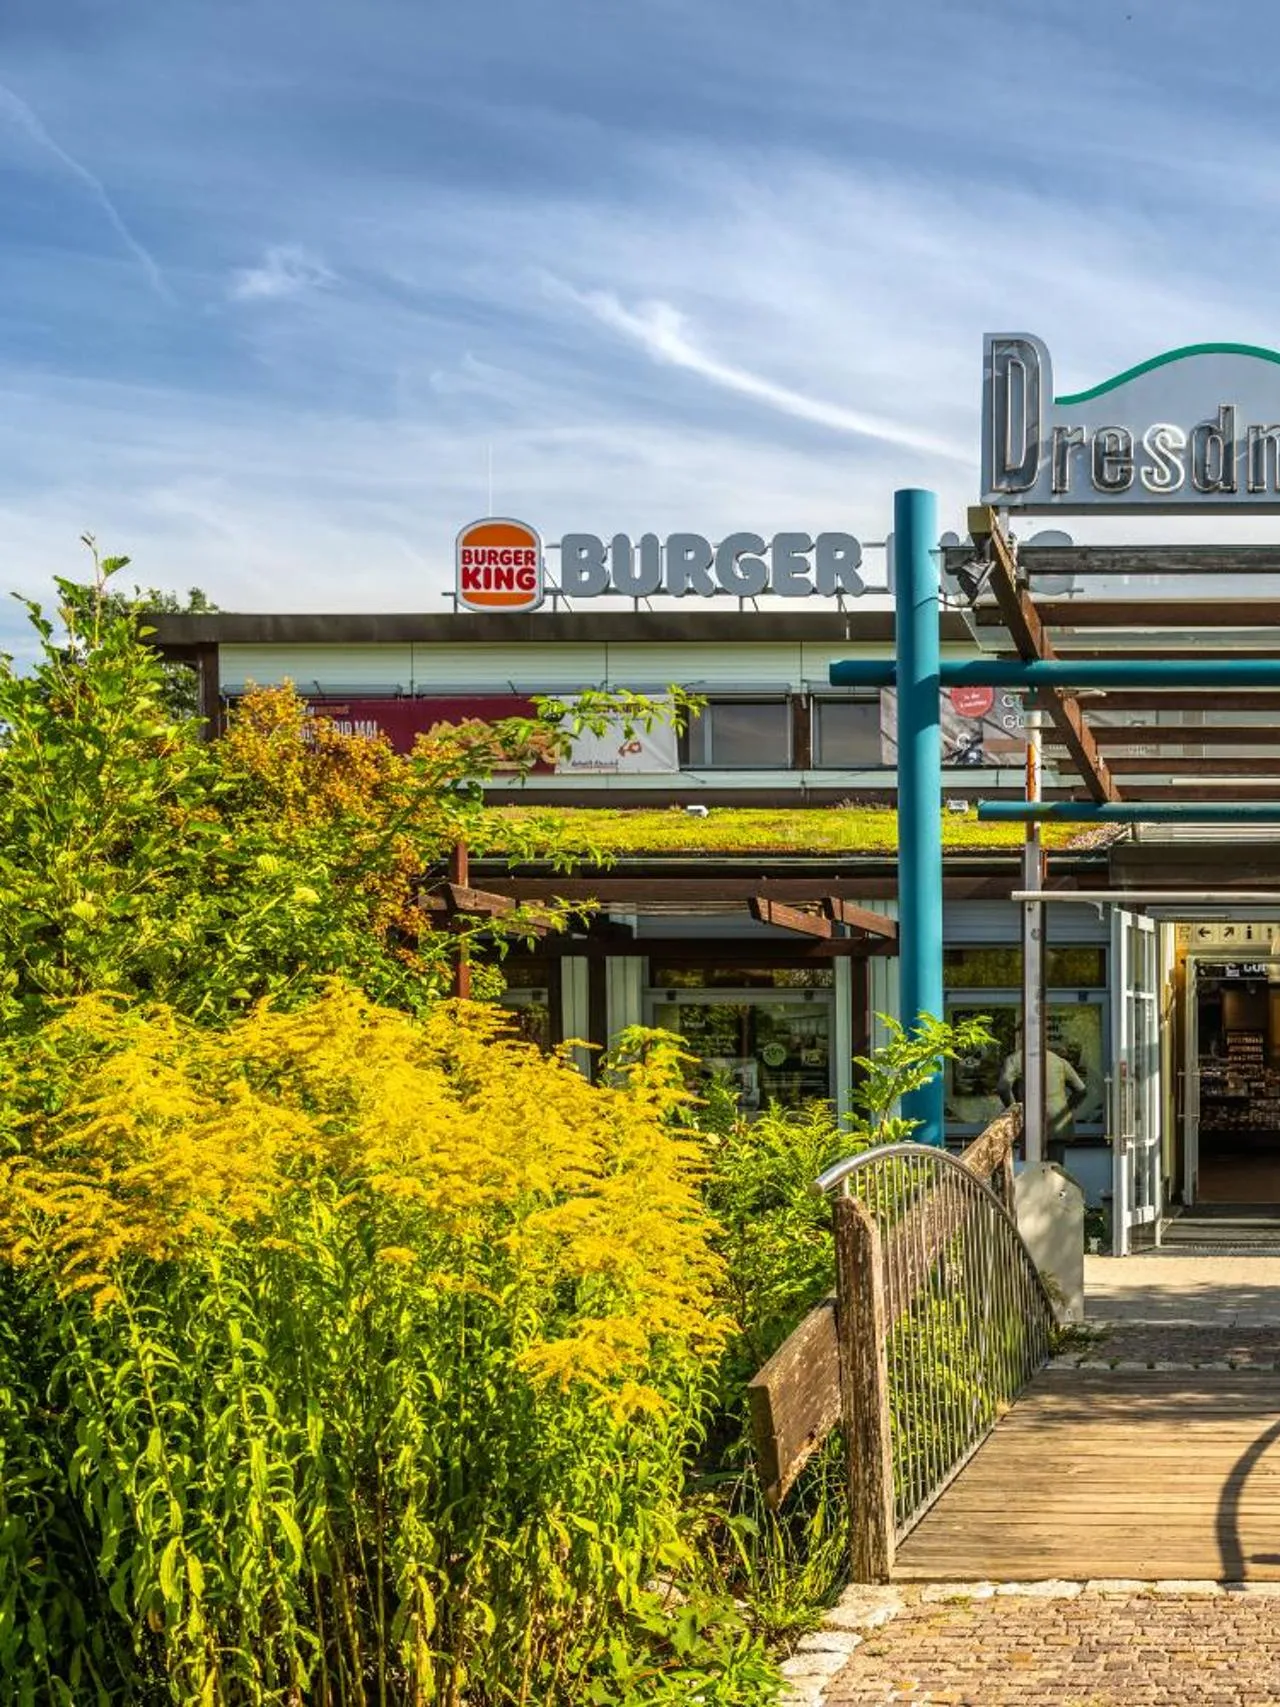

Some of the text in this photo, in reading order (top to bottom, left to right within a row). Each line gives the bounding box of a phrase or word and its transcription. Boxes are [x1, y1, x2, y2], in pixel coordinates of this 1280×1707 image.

[462, 549, 536, 566] BURGER
[560, 532, 866, 598] BURGER
[462, 566, 537, 591] KING
